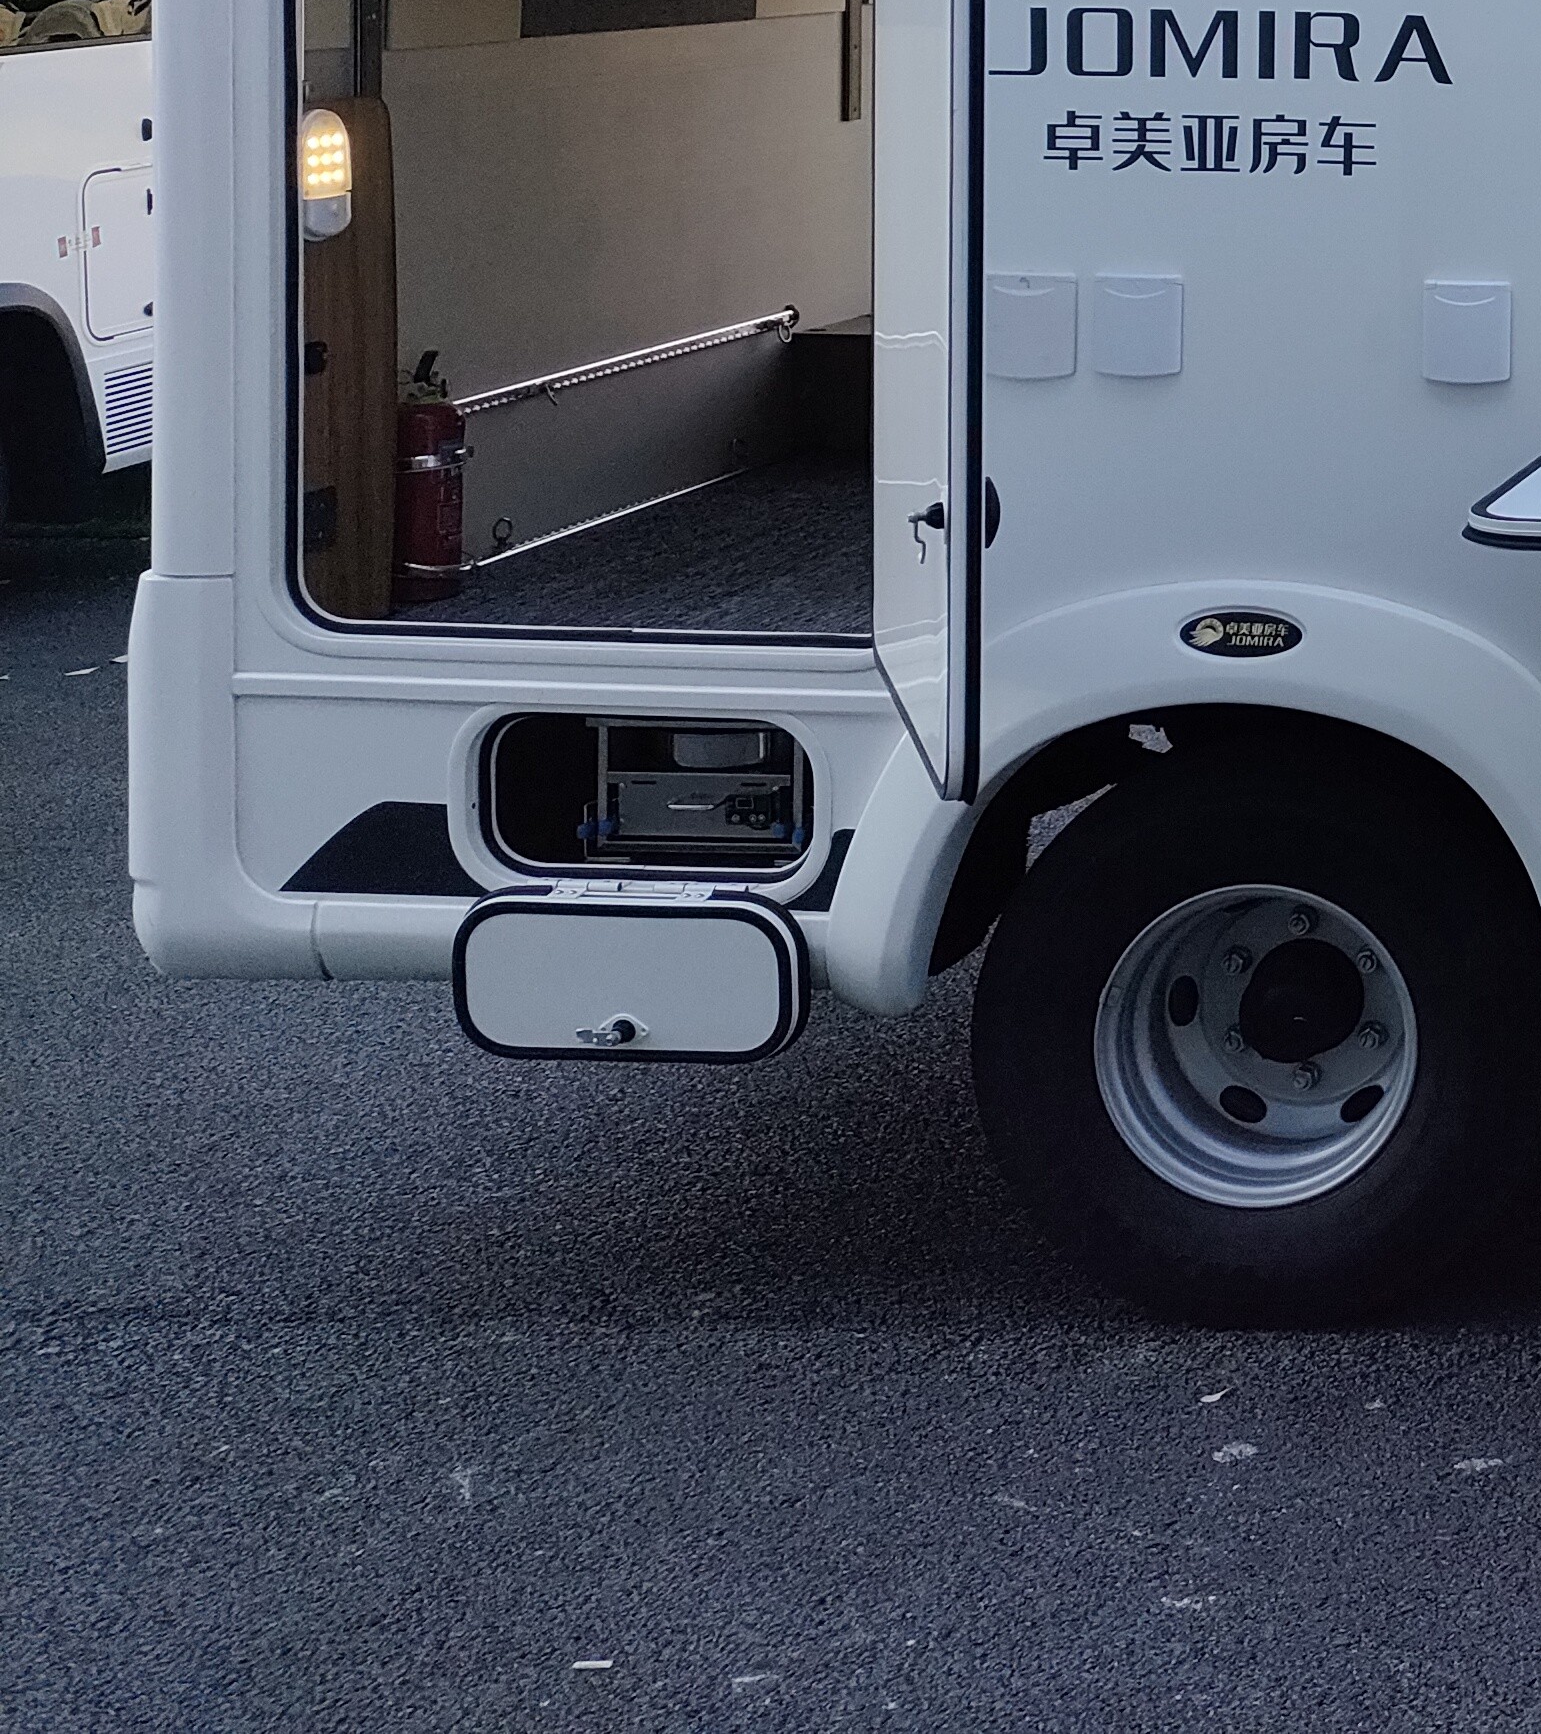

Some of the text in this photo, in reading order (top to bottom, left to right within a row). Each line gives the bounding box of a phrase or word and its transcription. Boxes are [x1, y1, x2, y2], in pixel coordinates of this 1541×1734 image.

[987, 6, 1454, 85] JOMIRA
[1042, 110, 1377, 176] 卓美亚房车
[1225, 621, 1289, 636] 卓美亚房车
[1226, 635, 1285, 647] JOMIRA
